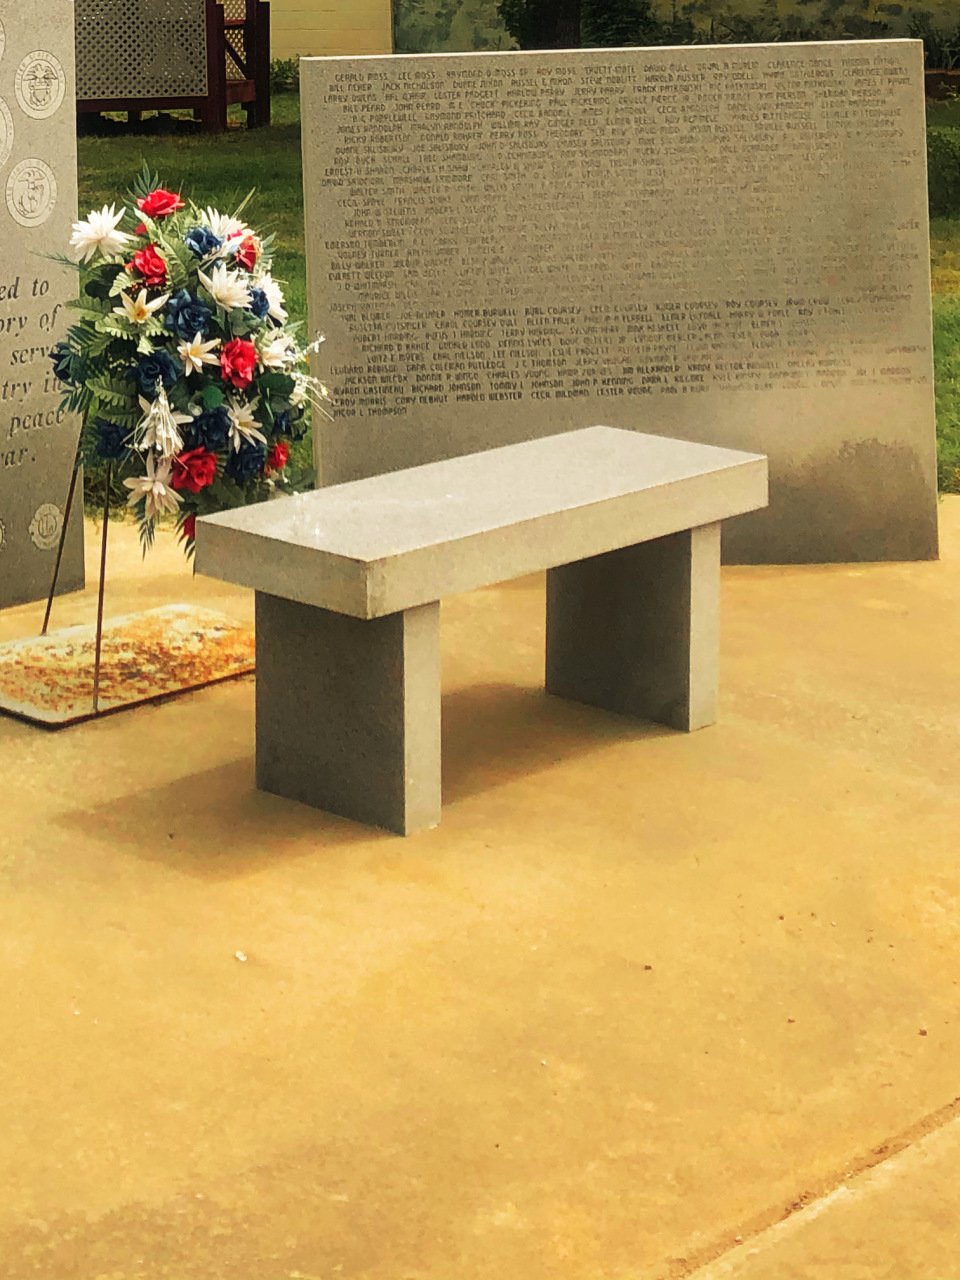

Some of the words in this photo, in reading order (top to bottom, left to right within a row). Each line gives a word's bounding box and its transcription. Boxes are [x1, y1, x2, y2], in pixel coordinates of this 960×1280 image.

[367, 72, 388, 81] MOSS
[414, 70, 435, 79] MOSS
[382, 82, 400, 91] JACK
[403, 80, 444, 90] NICHOLSON
[434, 90, 460, 100] LESTER
[31, 277, 49, 297] to
[39, 303, 62, 332] of
[8, 409, 67, 439] peace
